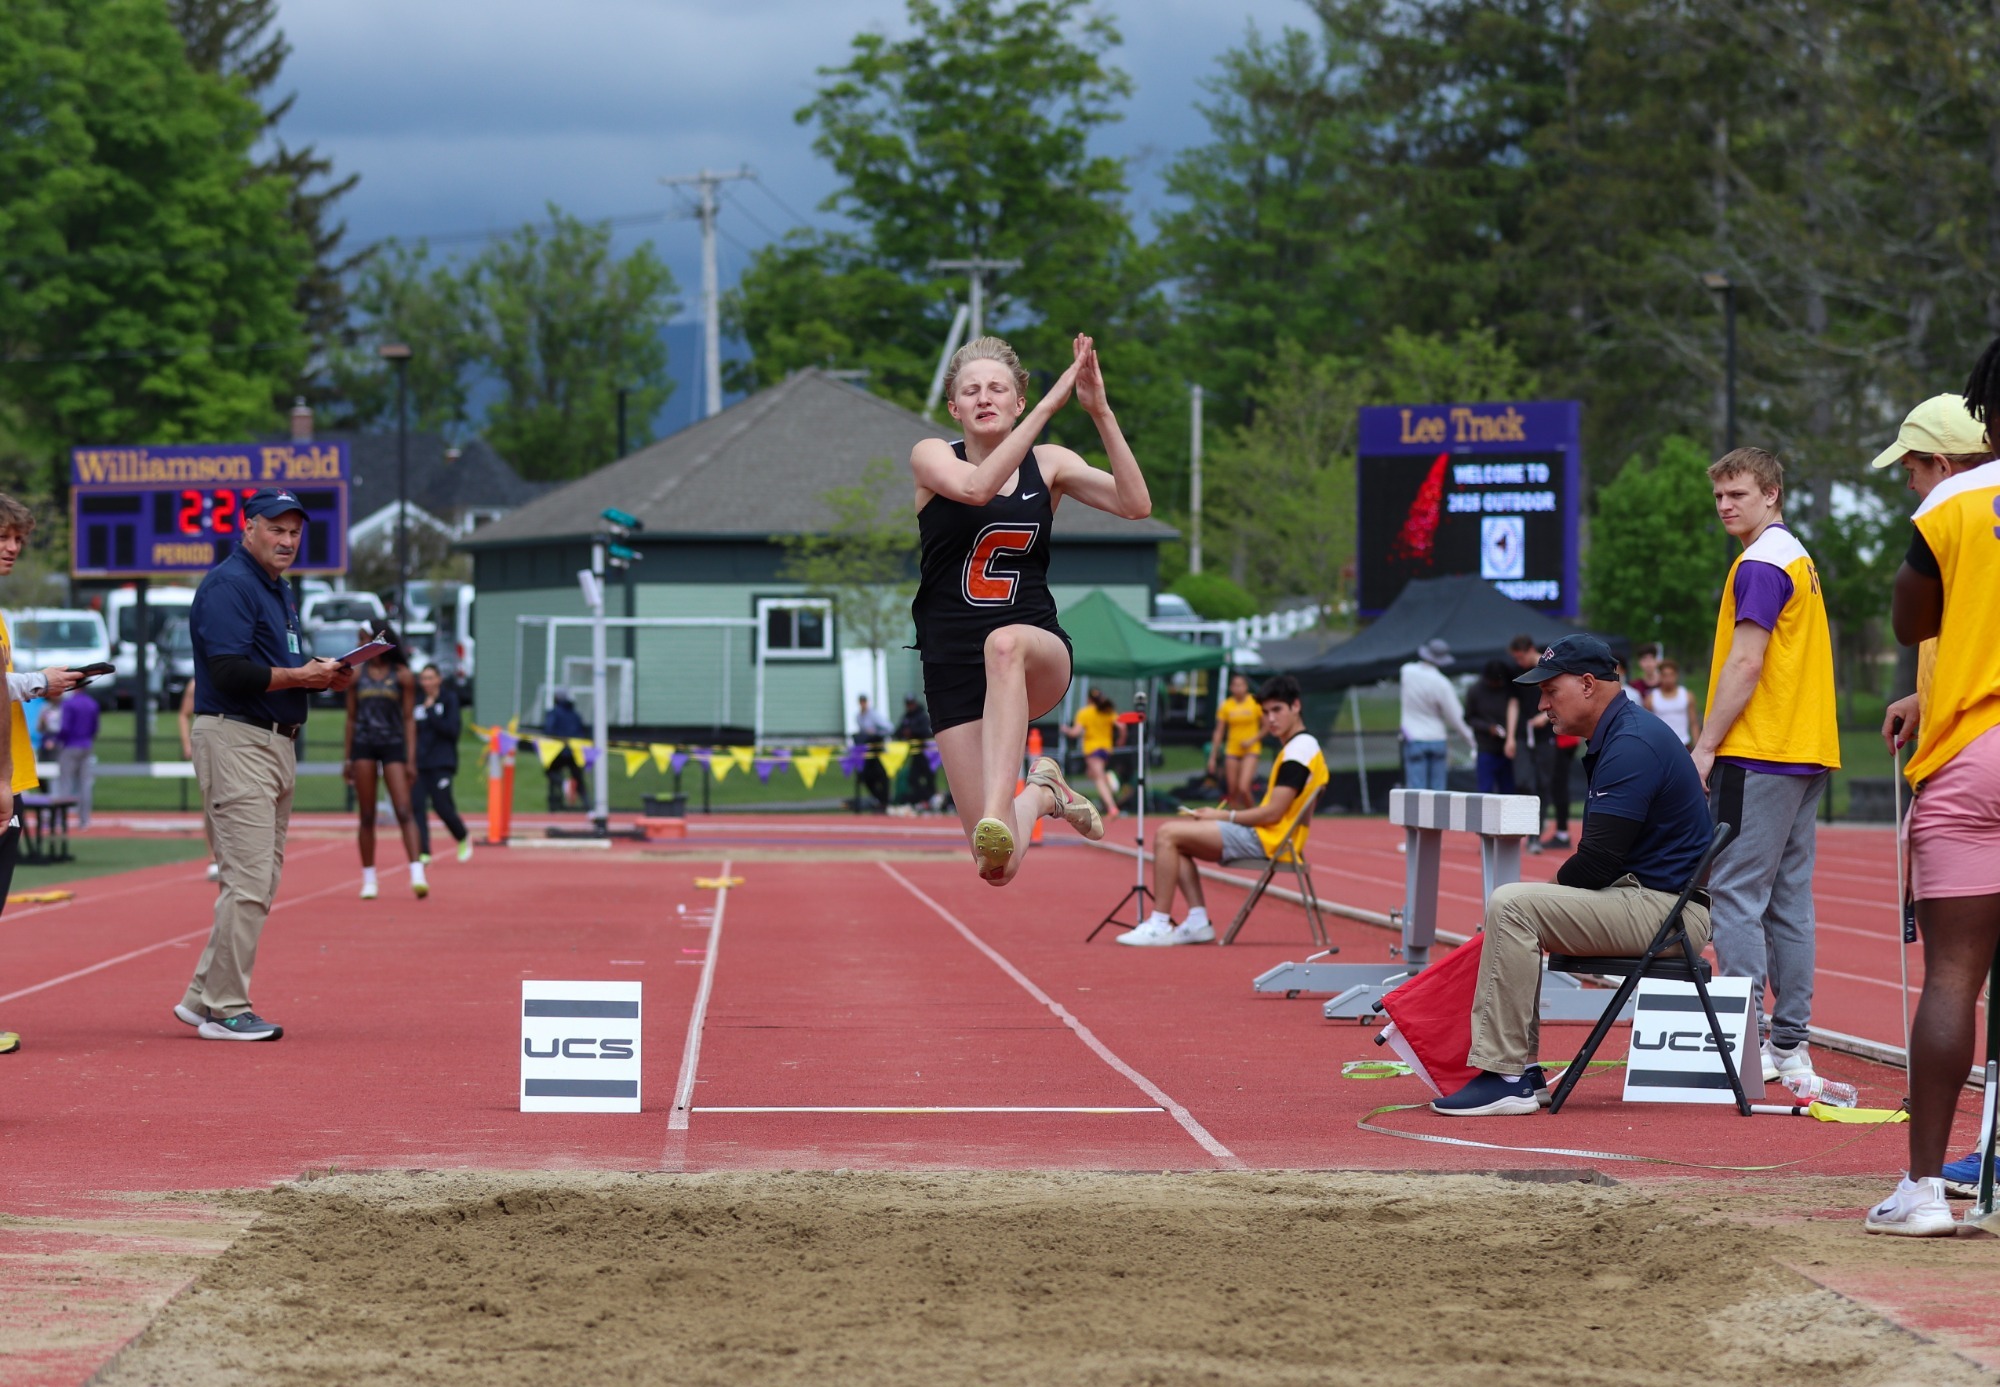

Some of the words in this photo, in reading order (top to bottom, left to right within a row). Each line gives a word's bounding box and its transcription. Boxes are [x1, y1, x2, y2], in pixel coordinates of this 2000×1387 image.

[1400, 409, 1446, 443] Lee
[1451, 406, 1526, 442] Track
[74, 449, 251, 483] Williamson
[260, 446, 341, 480] Field
[1453, 464, 1525, 484] WELCOME
[1526, 463, 1550, 483] TO
[1482, 491, 1557, 512] OUTDOOR
[153, 543, 214, 565] PERIOD
[962, 523, 1040, 607] C
[524, 1037, 634, 1059] UCS
[1633, 1030, 1736, 1052] UCS
